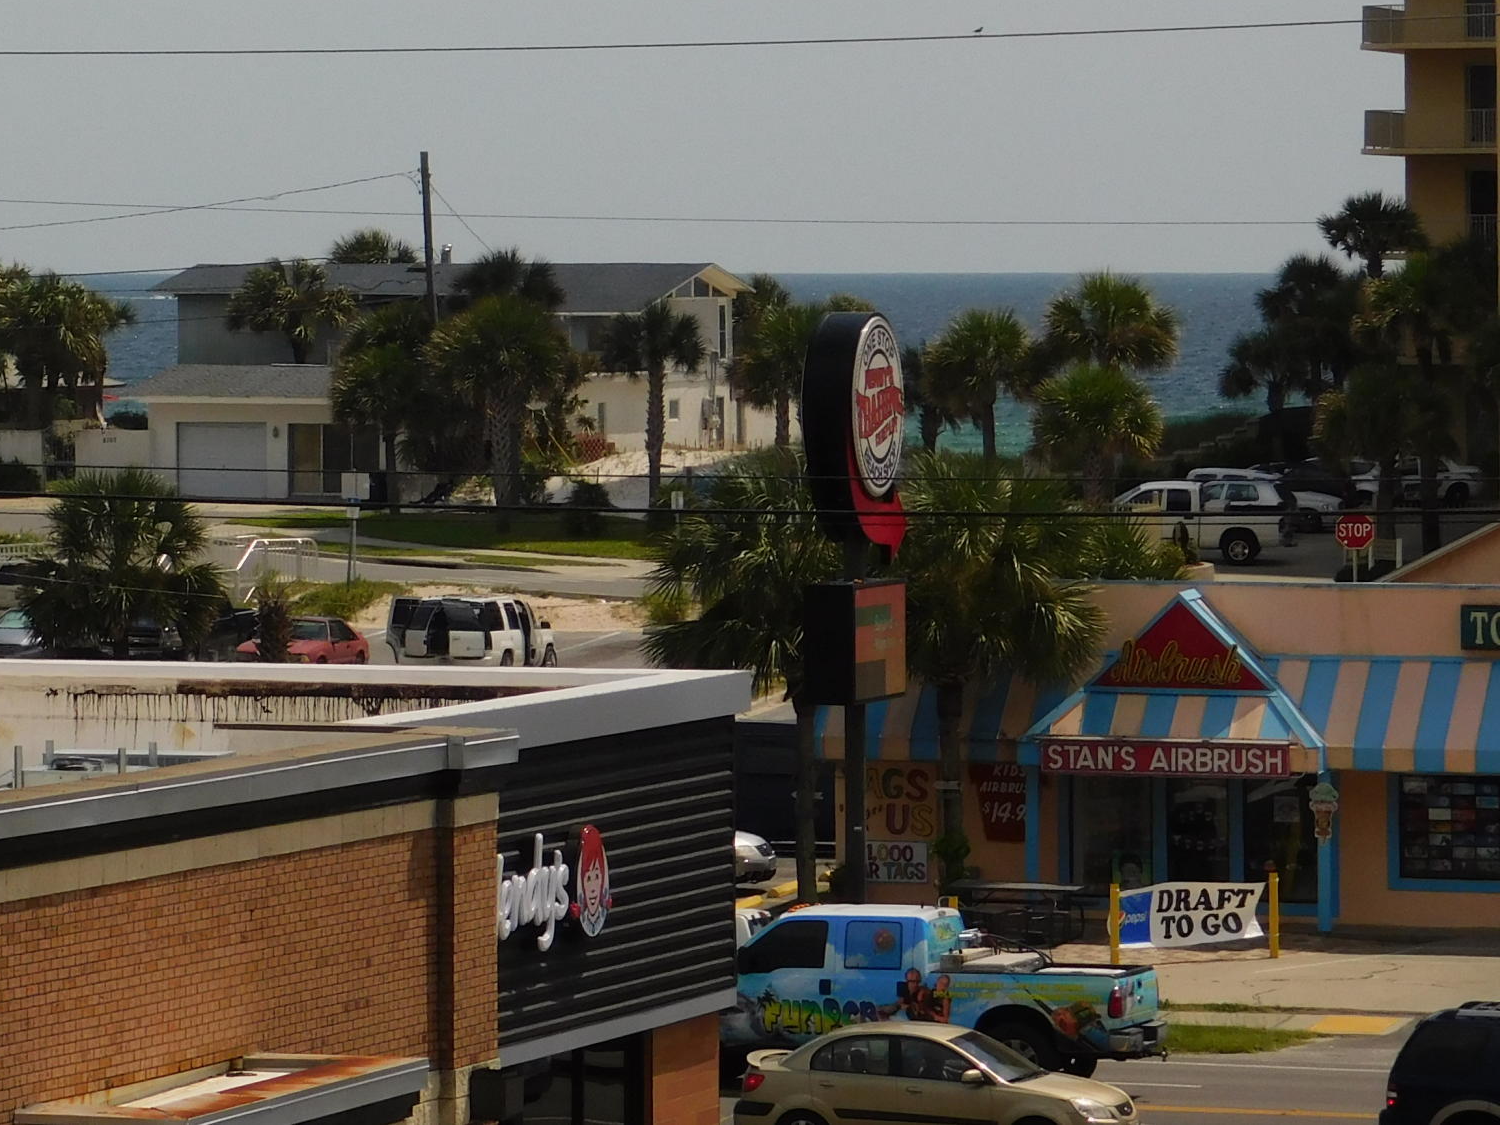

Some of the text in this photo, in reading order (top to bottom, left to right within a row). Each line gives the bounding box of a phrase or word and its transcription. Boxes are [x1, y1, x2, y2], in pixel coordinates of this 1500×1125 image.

[877, 331, 895, 358] STOP
[1338, 523, 1372, 538] STOP
[1111, 638, 1243, 686] Airbrush
[1048, 745, 1283, 775] STAN'S AIRBRUSH
[866, 768, 930, 803] AGS
[886, 802, 934, 837] US
[982, 801, 1027, 824] $14.9
[883, 861, 926, 881] TAGS
[1156, 888, 1255, 914] DRAFT
[1125, 910, 1148, 926] pepsi
[1161, 911, 1243, 940] TO GO
